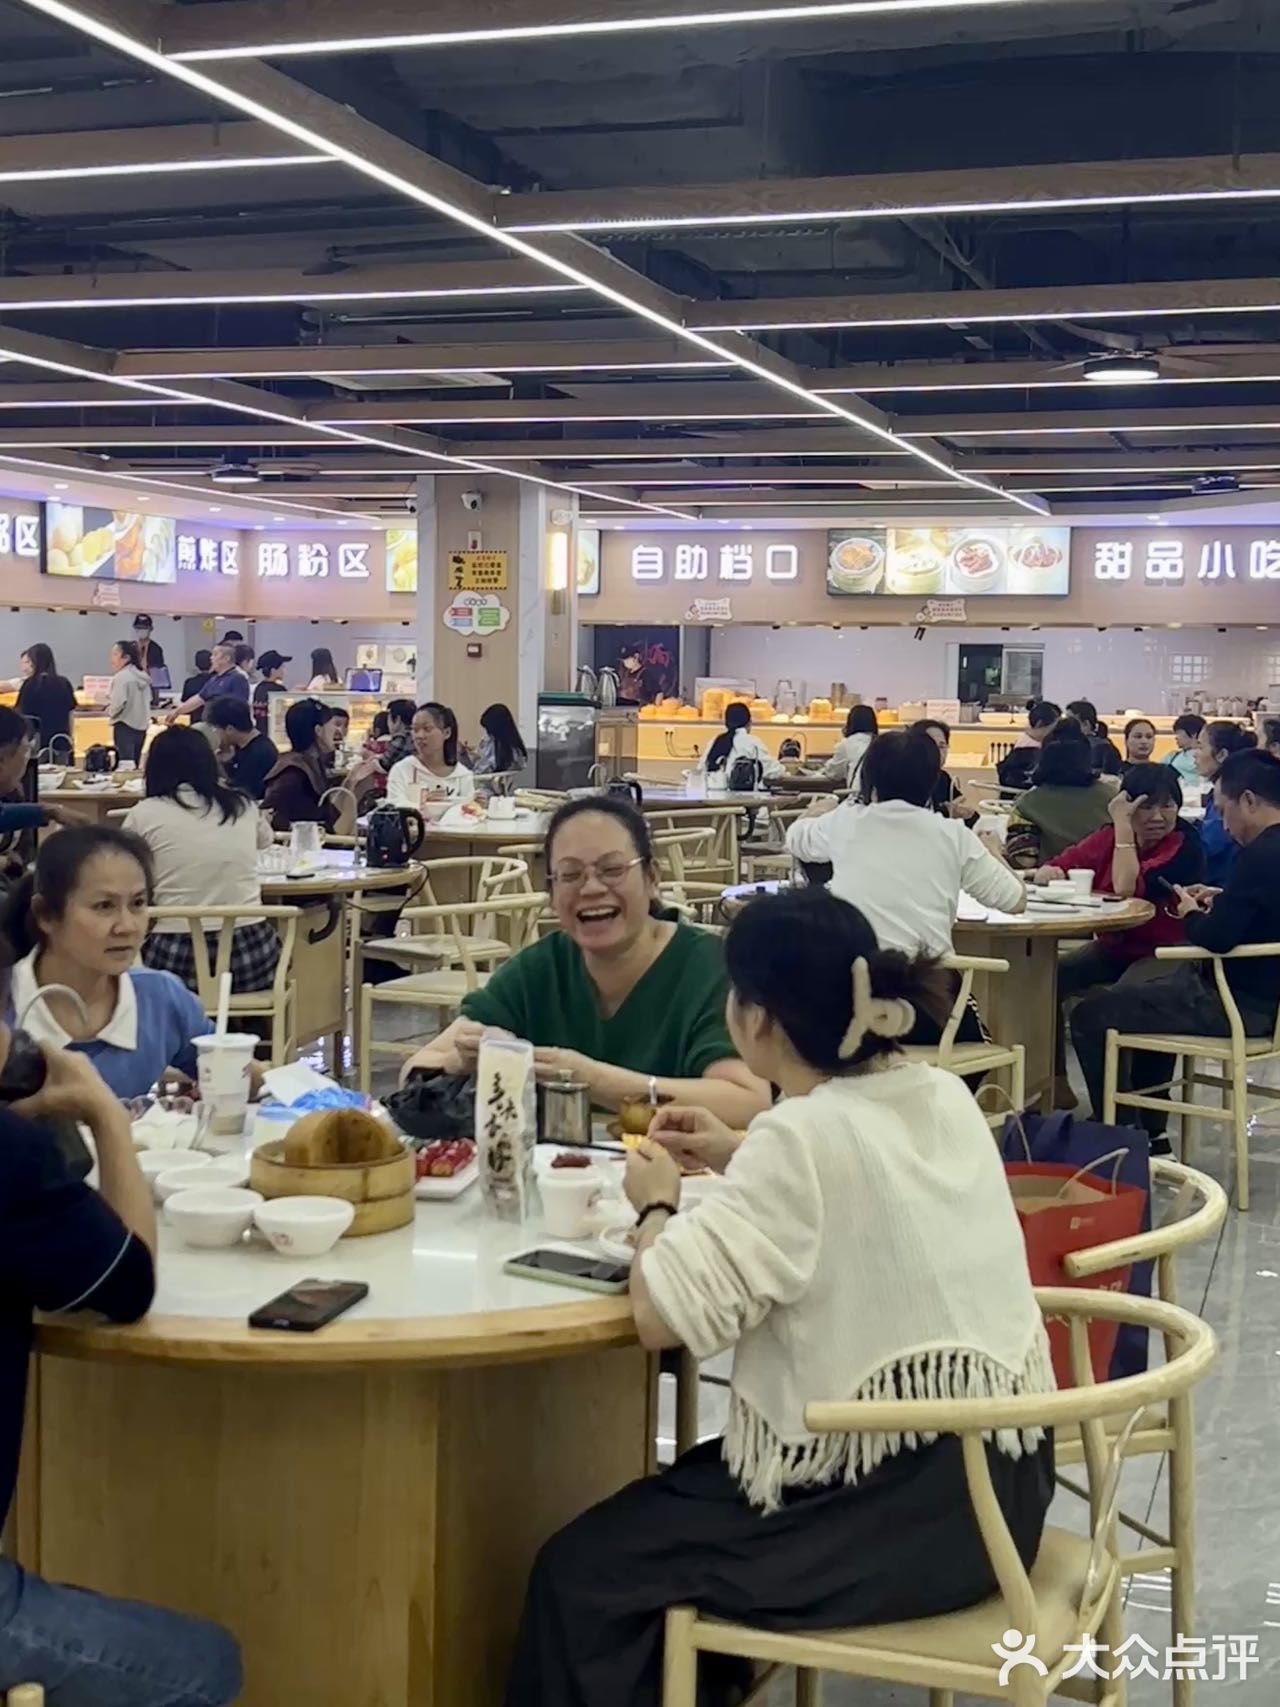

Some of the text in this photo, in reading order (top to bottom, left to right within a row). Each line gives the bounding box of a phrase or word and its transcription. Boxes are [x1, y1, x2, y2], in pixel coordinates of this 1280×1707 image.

[177, 535, 240, 575] 煎炸区
[257, 542, 370, 577] 肠粉区
[631, 544, 798, 580] 自助档口
[1094, 540, 1280, 580] 甜品小吃
